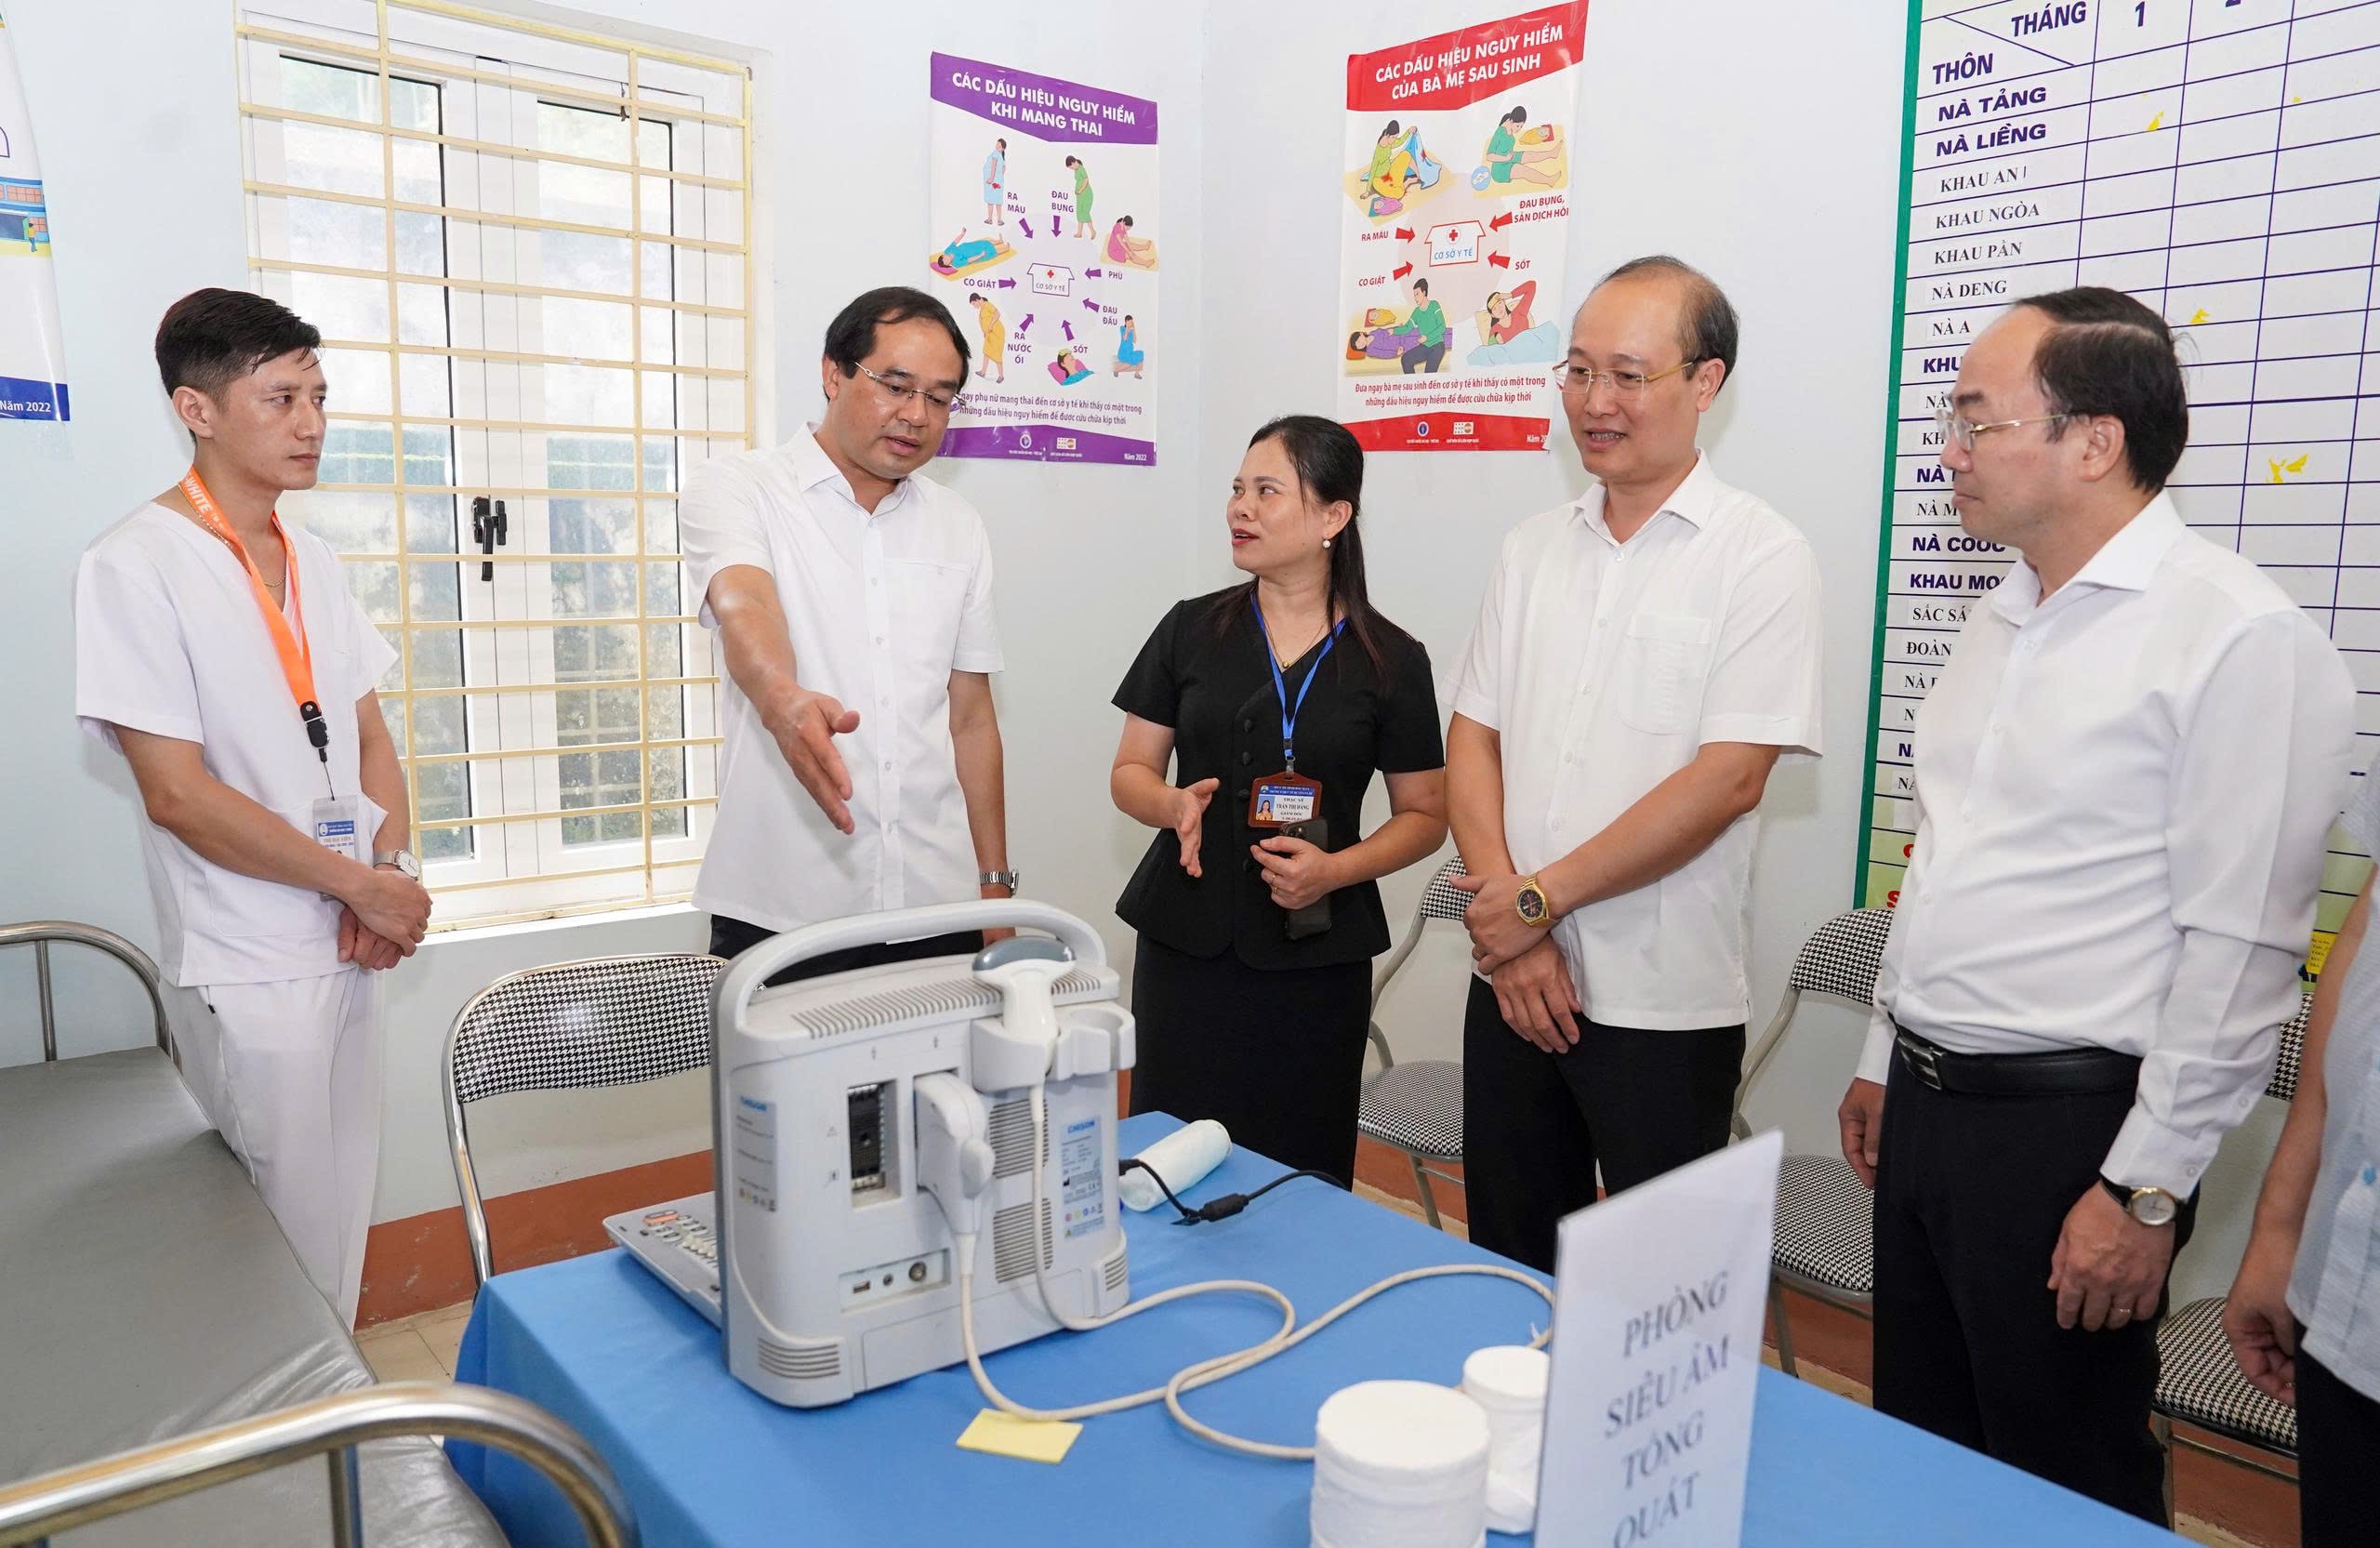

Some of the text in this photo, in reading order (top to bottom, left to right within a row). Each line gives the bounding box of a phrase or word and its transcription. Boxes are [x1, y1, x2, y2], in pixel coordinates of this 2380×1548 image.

[2012, 2, 2145, 37] THÁNG 1
[1376, 22, 1563, 83] CÁC DẤU HIỆU NGUY HIỂM
[1392, 53, 1540, 99] CỦA BÀ MẸ SAU SINH
[1933, 53, 1993, 84] THÔN
[952, 72, 1135, 125] CÁC DẤU HIỆU NGUY HIỂM
[1938, 86, 2046, 122] NÀ TẢNG
[991, 101, 1103, 136] KHI MANG THAI
[1937, 122, 2046, 156] NÀ LIỀNG
[1941, 167, 2018, 192] KHAU AN
[1008, 192, 1018, 200] RA
[1051, 191, 1068, 200] ĐAU
[1520, 195, 1564, 208] ĐAU BỤNG,
[1008, 204, 1025, 214] MÁU
[1051, 203, 1074, 213] BỤNG
[1533, 210, 1553, 222] DỊCH
[1936, 201, 2040, 230] KHAU NGÒA
[1372, 231, 1389, 240] MÁU
[1435, 251, 1444, 259] CƠ
[1935, 246, 1987, 264] KHAU
[963, 278, 996, 290] CO GIẬT
[1369, 275, 1385, 287] GIẬT
[1932, 280, 2007, 300] NÀ DENG
[1103, 306, 1117, 314] ĐAU
[1932, 318, 1971, 336] NÀ A
[1008, 342, 1032, 352] NƯỚC
[1924, 357, 1962, 373] KHU
[1355, 383, 1367, 392] Đưa
[1368, 385, 1382, 394] ngay
[1393, 384, 1402, 392] mẹ
[1414, 381, 1426, 390] sinh
[1428, 379, 1441, 389] đến
[1460, 381, 1464, 390] y
[1473, 378, 1483, 388] khi
[1510, 377, 1524, 388] một
[1527, 377, 1545, 387] trong
[0, 401, 51, 413] Năm 2022
[1000, 396, 1018, 405] mang
[1020, 395, 1033, 404] thai
[1036, 397, 1048, 405] đến
[1079, 400, 1089, 408] khi
[1126, 404, 1142, 415] trong
[1366, 397, 1385, 407] những
[1413, 398, 1428, 407] nguy
[1458, 394, 1473, 404] được
[1487, 392, 1502, 402] chữa
[1504, 392, 1515, 404] kịp
[1926, 391, 1947, 408] NÀ
[1014, 411, 1029, 420] nguy
[1527, 434, 1540, 443] Năm
[1923, 432, 1945, 444] KH
[1917, 465, 1945, 483] NÀ
[185, 476, 213, 513] WHITE
[1917, 499, 1958, 516] NÀ M
[1912, 534, 1941, 551] NÀ
[1911, 574, 2005, 589] KHAU MO
[1948, 605, 1971, 622] SÁ
[1906, 640, 1952, 656] ĐOÀN
[1904, 672, 1925, 688] NÀ
[1904, 708, 1915, 721] N
[1898, 743, 1913, 758] N
[1623, 1270, 1729, 1357] PHÒNG
[1605, 1333, 1729, 1438] SIÊU ÂM
[1621, 1409, 1705, 1489] TỔNG
